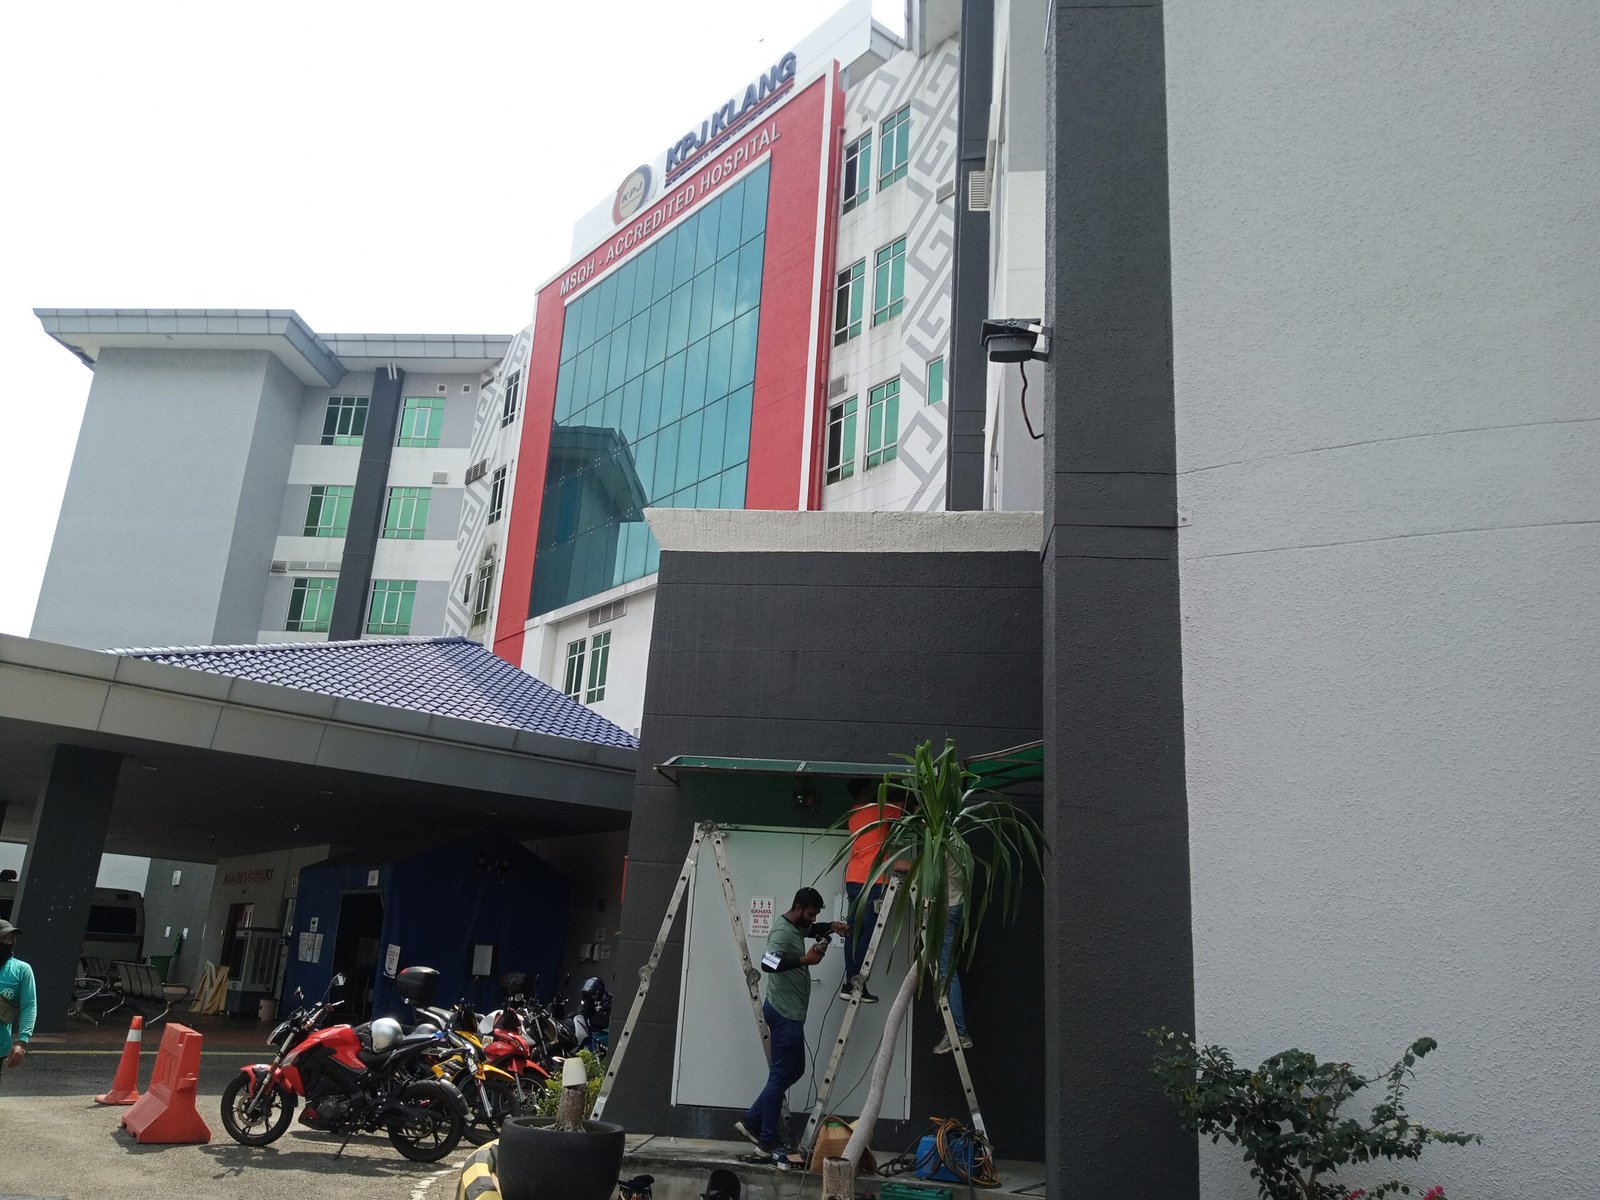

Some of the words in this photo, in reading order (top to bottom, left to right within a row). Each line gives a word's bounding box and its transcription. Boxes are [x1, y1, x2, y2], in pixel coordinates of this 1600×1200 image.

[665, 120, 708, 172] KPJ
[711, 52, 796, 137] KLANG
[559, 258, 595, 297] MSQH
[606, 185, 696, 265] ACCREDITED
[699, 122, 781, 195] HOSPITAL
[621, 181, 643, 205] KPJ
